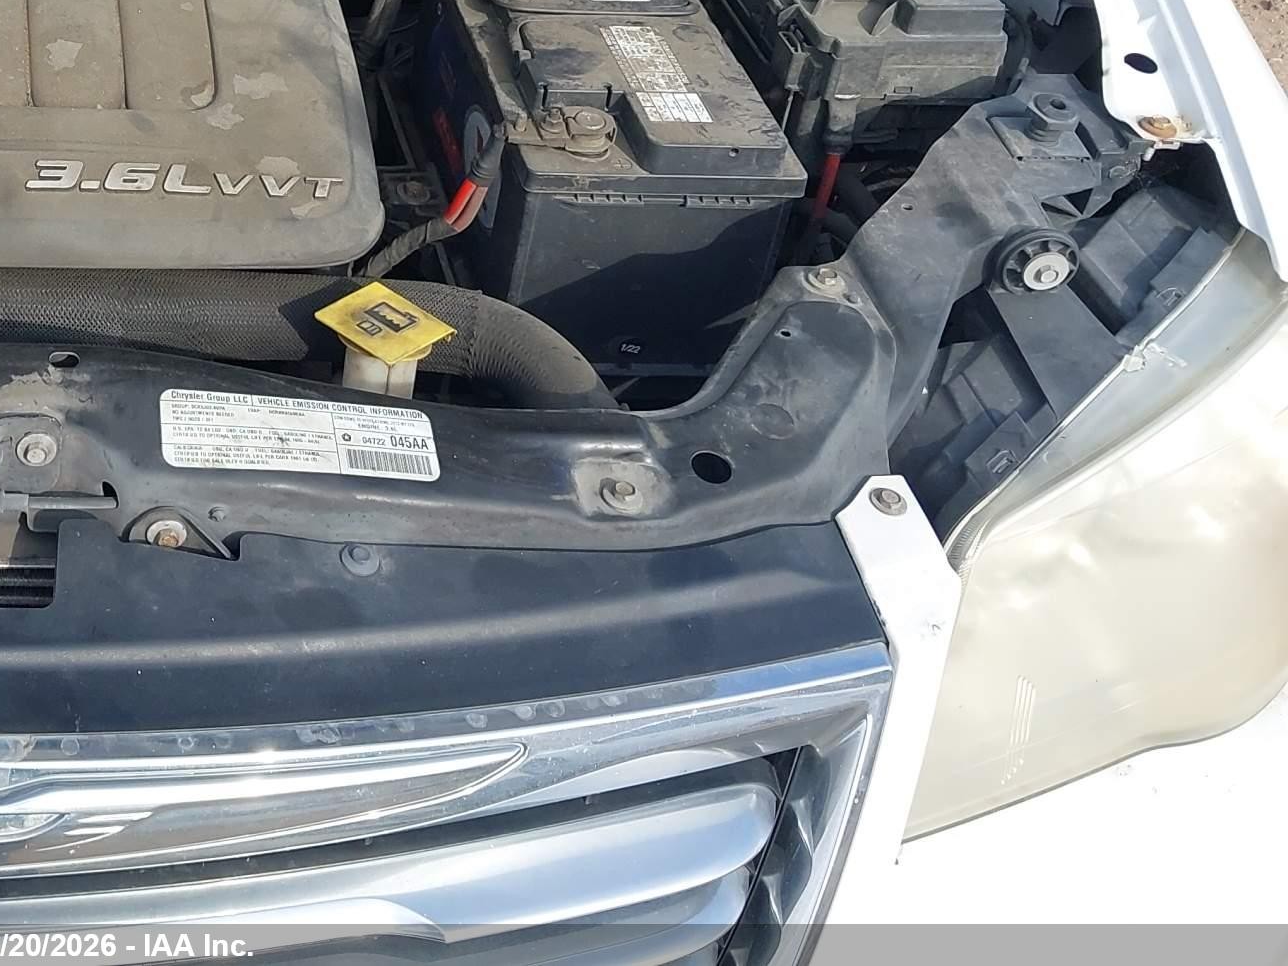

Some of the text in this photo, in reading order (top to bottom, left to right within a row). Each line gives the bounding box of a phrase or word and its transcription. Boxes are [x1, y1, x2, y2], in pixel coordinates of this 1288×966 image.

[621, 344, 641, 354] 1/22
[171, 390, 249, 404] Chrysler Group LLC
[257, 397, 424, 419] VEHICLE EMISSION CONTROL INFORMATION
[361, 434, 430, 451] 04722 045AA
